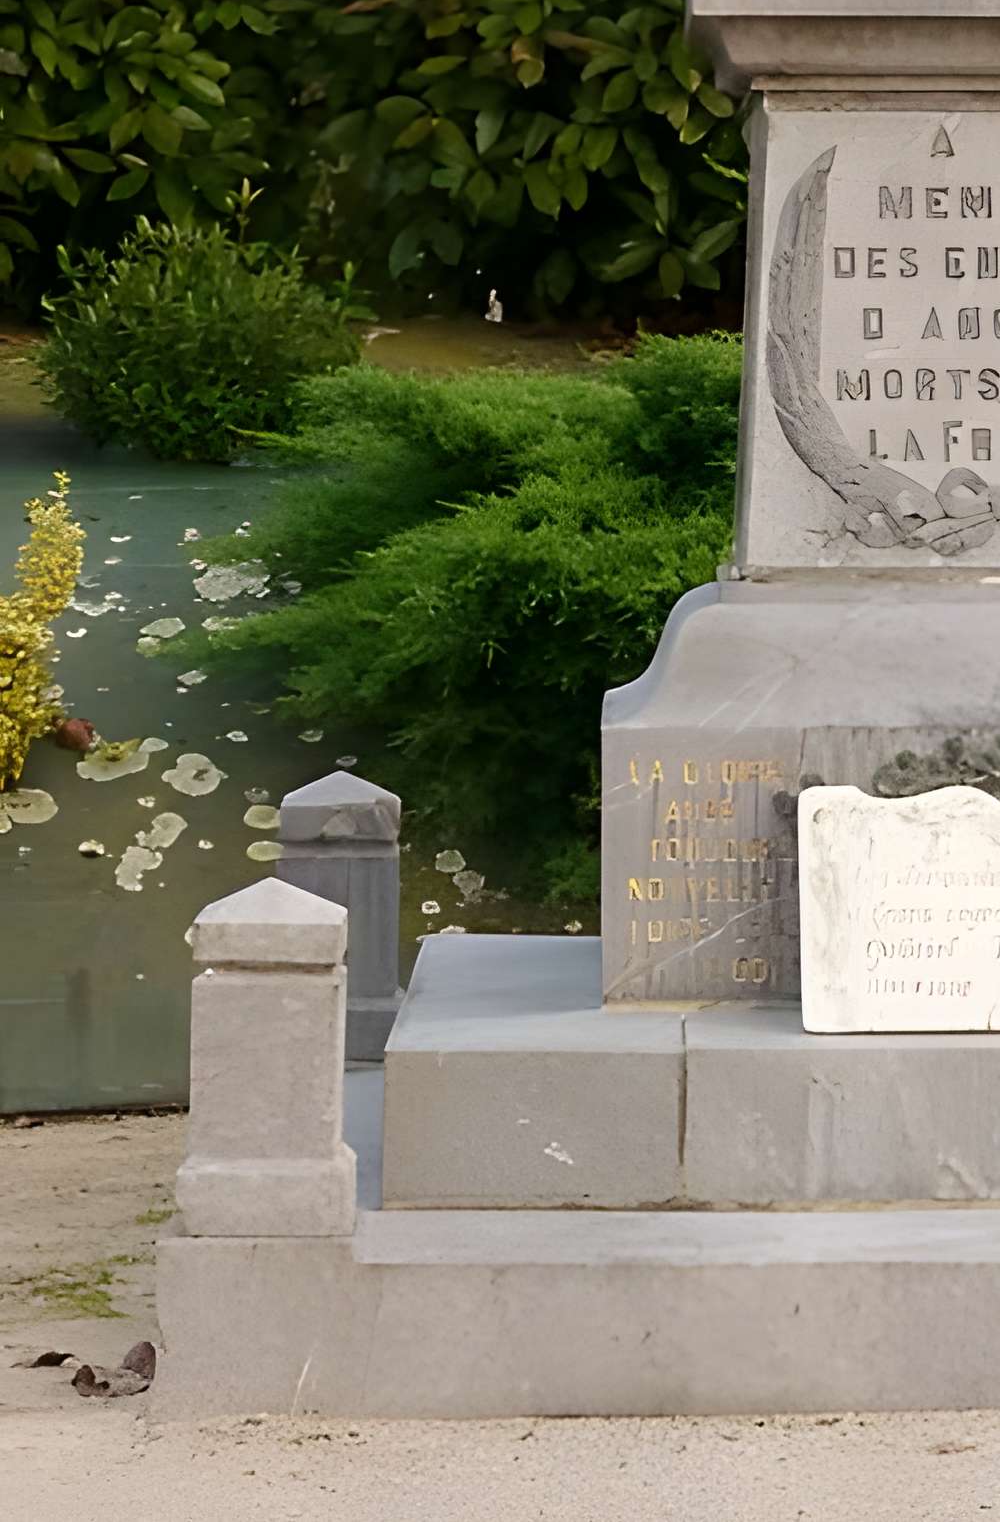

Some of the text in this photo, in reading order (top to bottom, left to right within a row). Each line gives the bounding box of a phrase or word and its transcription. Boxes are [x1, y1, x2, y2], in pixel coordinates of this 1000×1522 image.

[930, 125, 955, 157] A
[833, 247, 919, 279] DES
[836, 368, 1000, 401] MORTS
